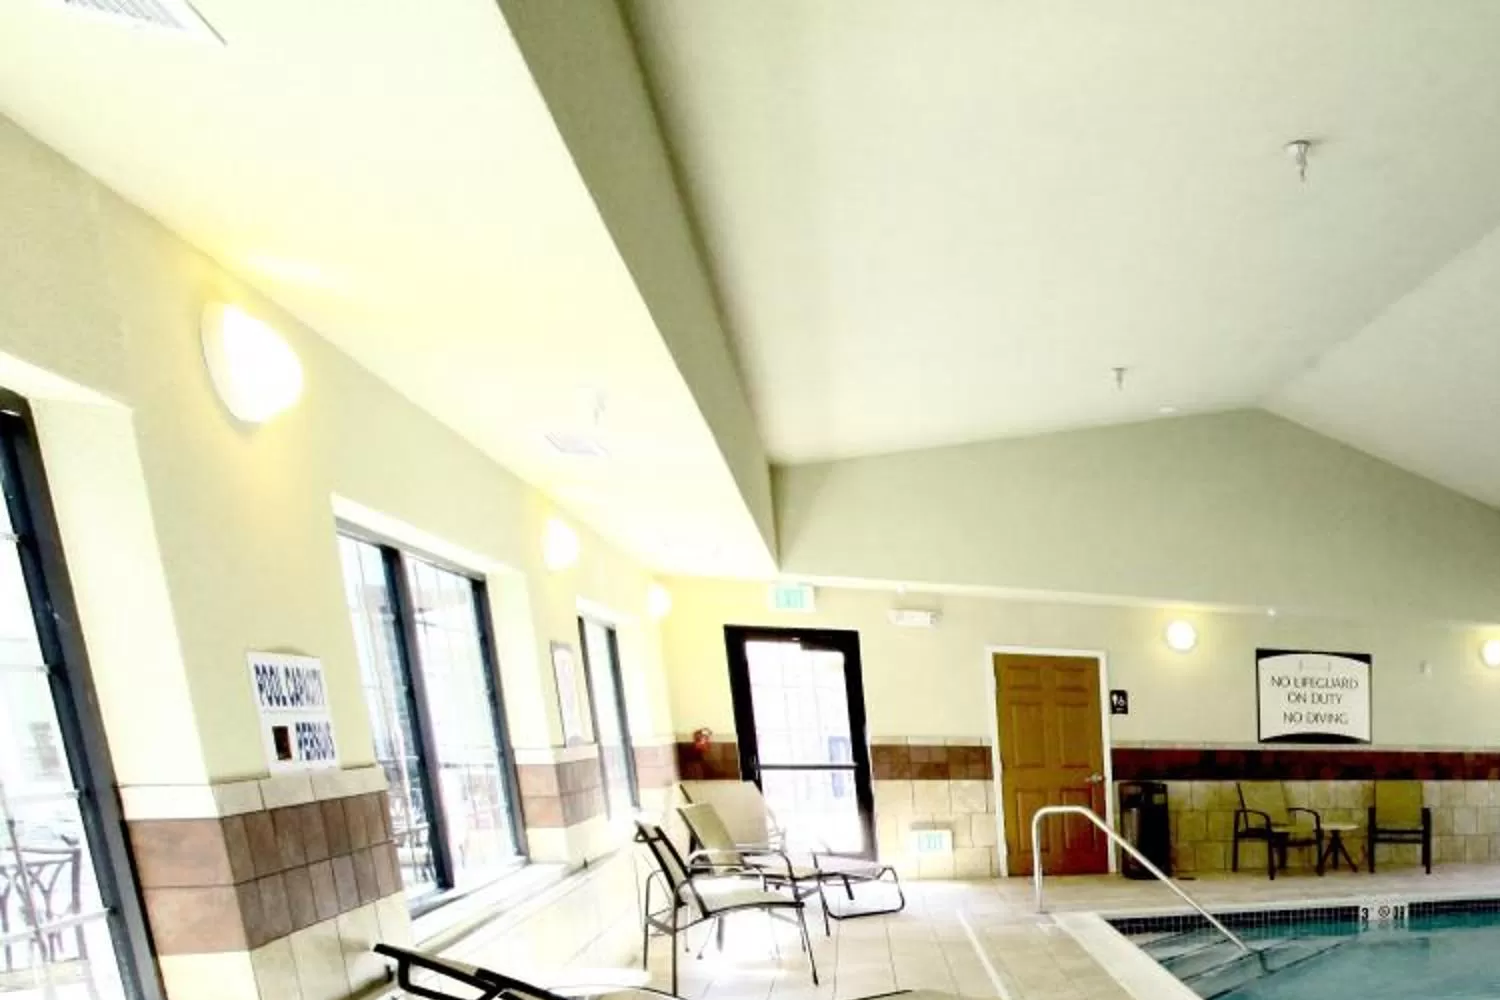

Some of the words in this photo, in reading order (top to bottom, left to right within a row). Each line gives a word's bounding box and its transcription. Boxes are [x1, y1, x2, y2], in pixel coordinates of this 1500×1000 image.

[254, 664, 287, 706] POOL
[1271, 675, 1292, 689] NO
[1294, 676, 1359, 689] LIFEGUARD
[1287, 691, 1307, 704] ON
[1311, 692, 1342, 705] DUTY
[1283, 711, 1303, 724] NO
[1306, 712, 1349, 725] DIVING
